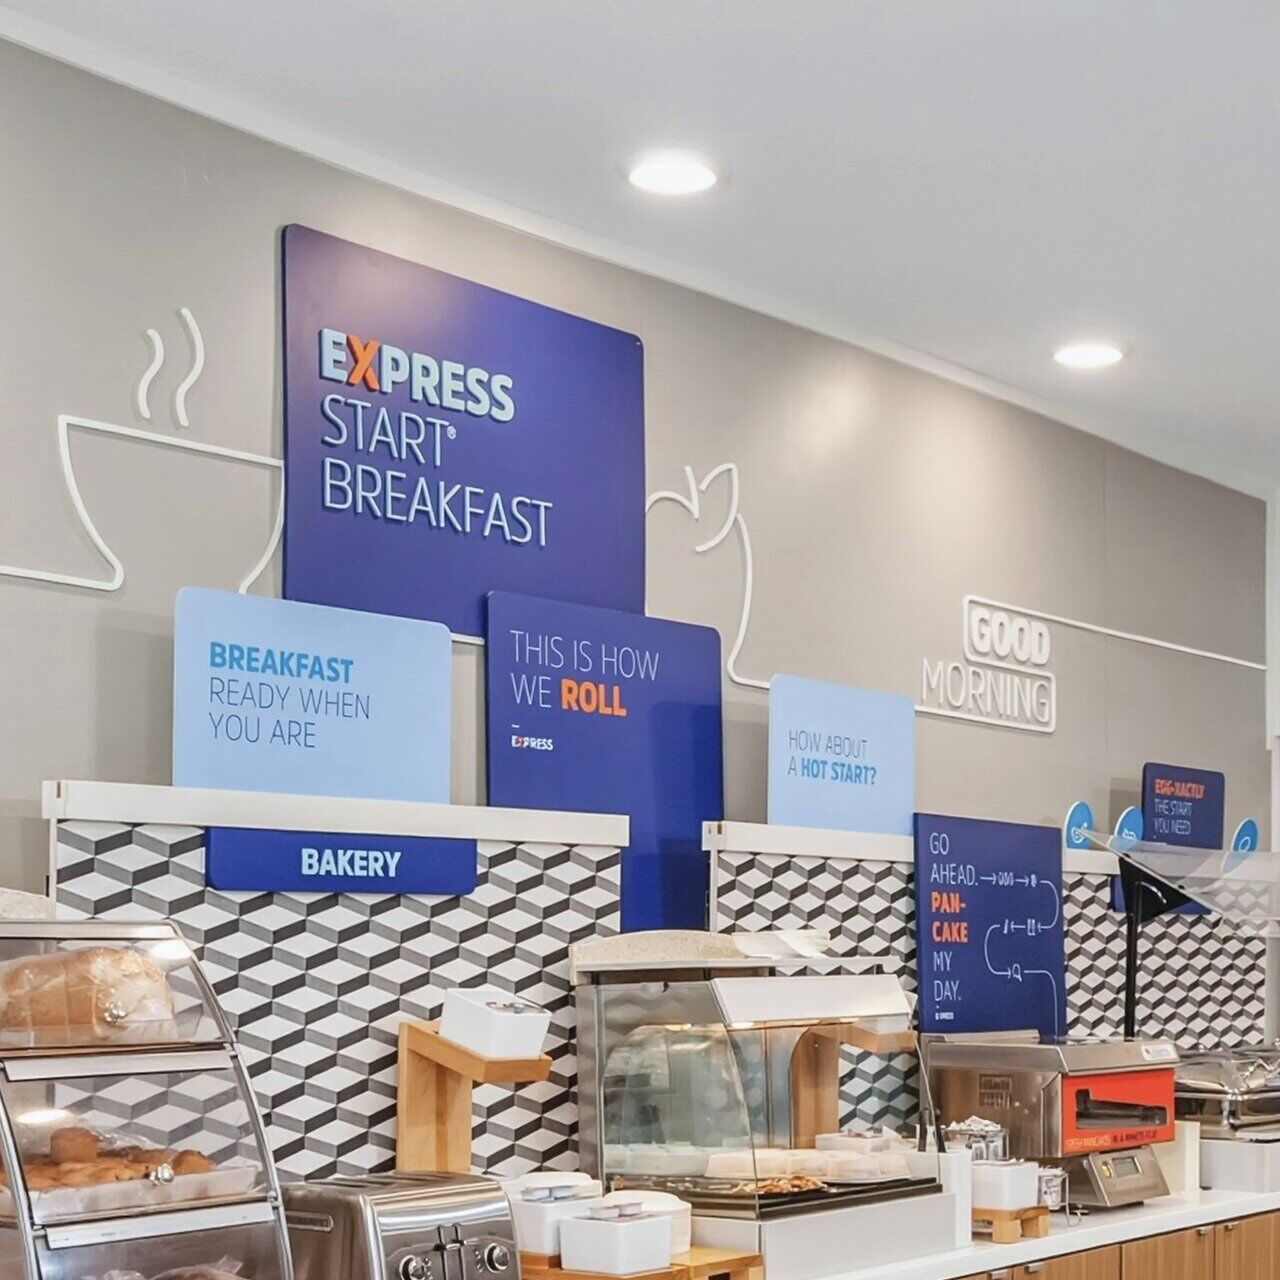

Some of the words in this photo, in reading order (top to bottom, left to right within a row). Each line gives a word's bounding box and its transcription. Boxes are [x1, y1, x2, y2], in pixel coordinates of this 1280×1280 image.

[319, 327, 516, 422] EXPRESS
[323, 457, 553, 547] BREAKFAST
[971, 607, 1050, 666] GOOD
[209, 641, 355, 684] BREAKFAST
[510, 629, 565, 669] THIS
[573, 639, 593, 673] IS
[601, 643, 660, 681] HOW
[209, 676, 291, 711] READY
[299, 686, 371, 720] WHEN
[510, 672, 552, 709] WE
[561, 678, 627, 717] ROLL
[922, 657, 1050, 724] MORNING
[208, 711, 261, 744] YOU
[269, 719, 317, 749] ARE
[511, 734, 554, 751] EXPRESS
[788, 729, 822, 753] HOW
[825, 735, 868, 760] ABOUT
[787, 756, 798, 777] A
[801, 757, 828, 780] HOT
[830, 761, 877, 786] START?
[929, 832, 950, 856] GO
[301, 847, 402, 878] BAKERY
[930, 863, 979, 887] AHEAD.
[930, 891, 967, 914] PAN-
[932, 920, 969, 944] CAKE
[933, 951, 953, 972] MY
[933, 979, 962, 1002] DAY.
